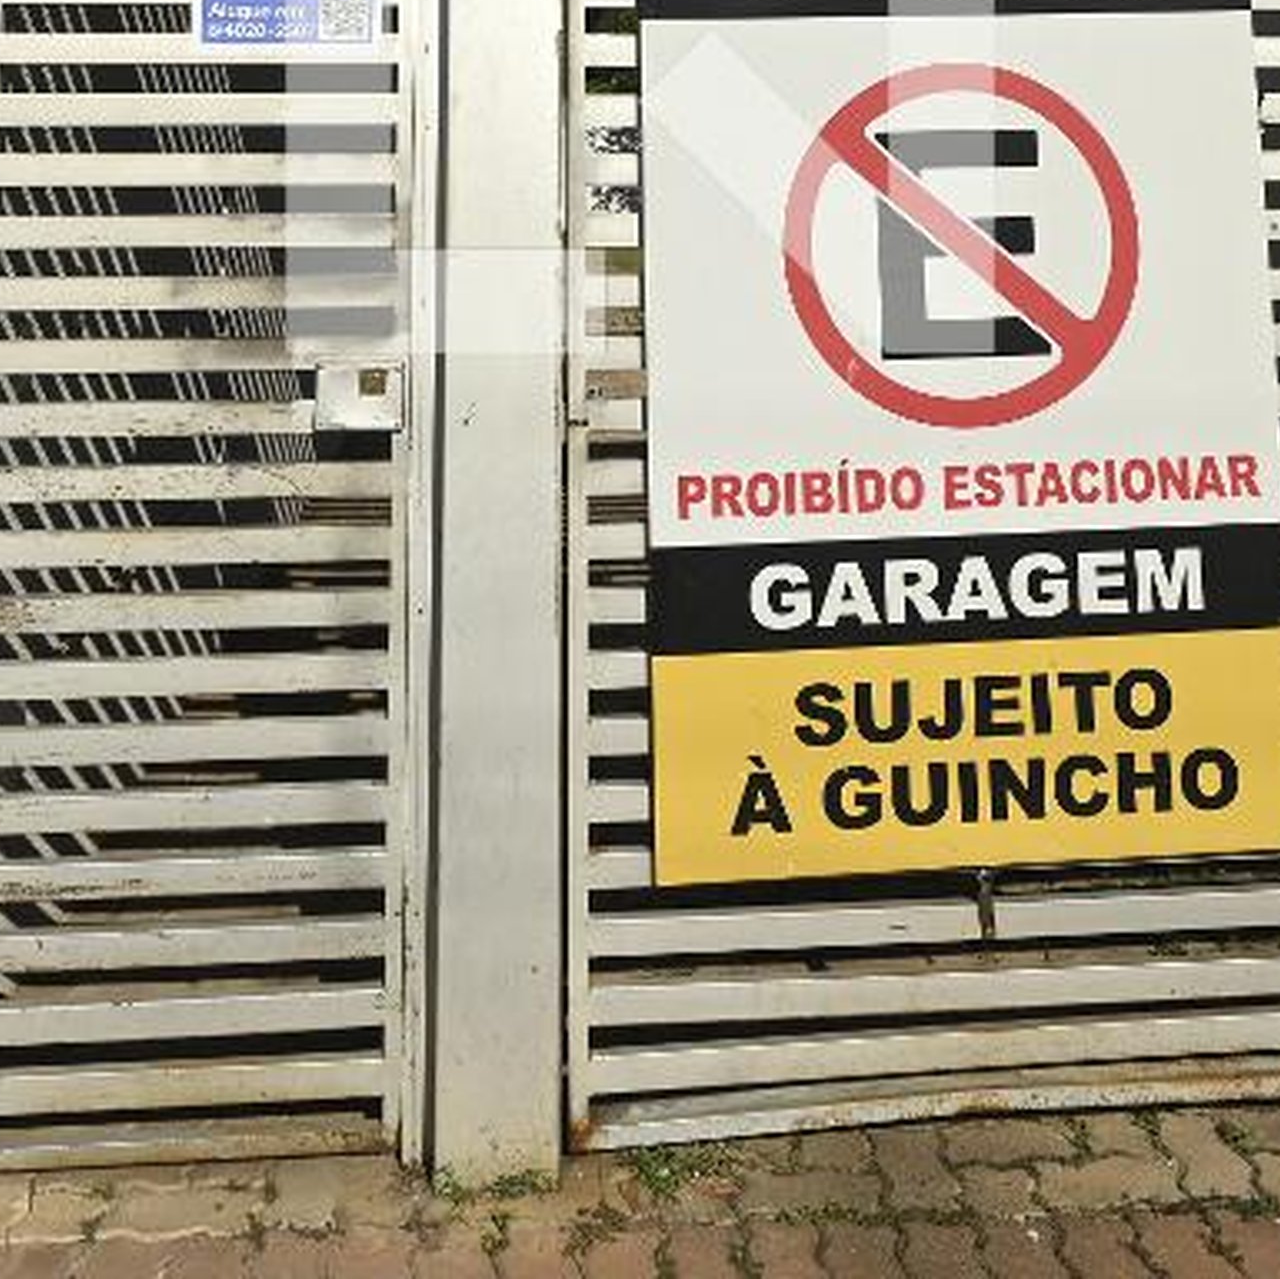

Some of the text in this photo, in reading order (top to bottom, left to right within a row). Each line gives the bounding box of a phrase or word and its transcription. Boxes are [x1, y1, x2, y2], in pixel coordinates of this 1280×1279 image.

[874, 128, 1052, 361] E
[677, 453, 1262, 520] PROIBÍDO ESTACIONAR
[749, 546, 1207, 631] GARAGEM
[793, 667, 1173, 748] SUJEITO
[730, 747, 1240, 837] À GUINCHO
